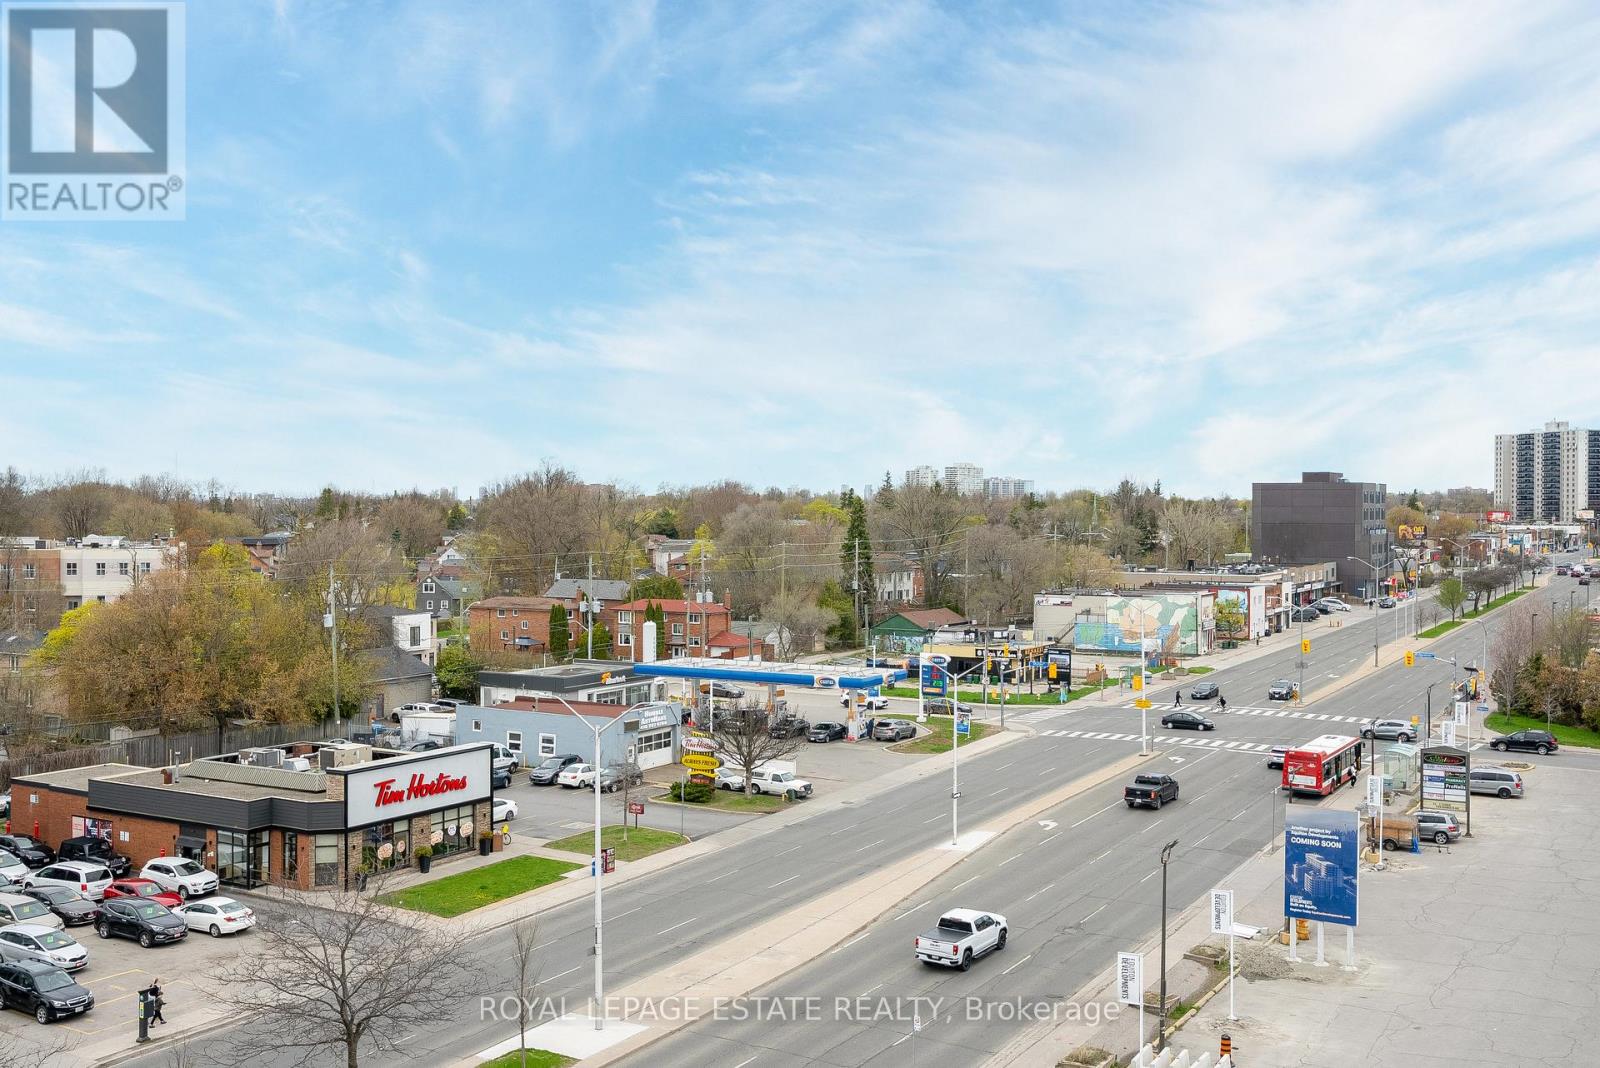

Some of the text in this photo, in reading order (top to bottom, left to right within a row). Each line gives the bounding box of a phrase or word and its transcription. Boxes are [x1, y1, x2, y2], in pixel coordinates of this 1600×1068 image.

[374, 772, 467, 808] Tim Hortons
[1291, 837, 1342, 849] COMING SOON
[1121, 957, 1129, 1000] DEVELOPMENTS
